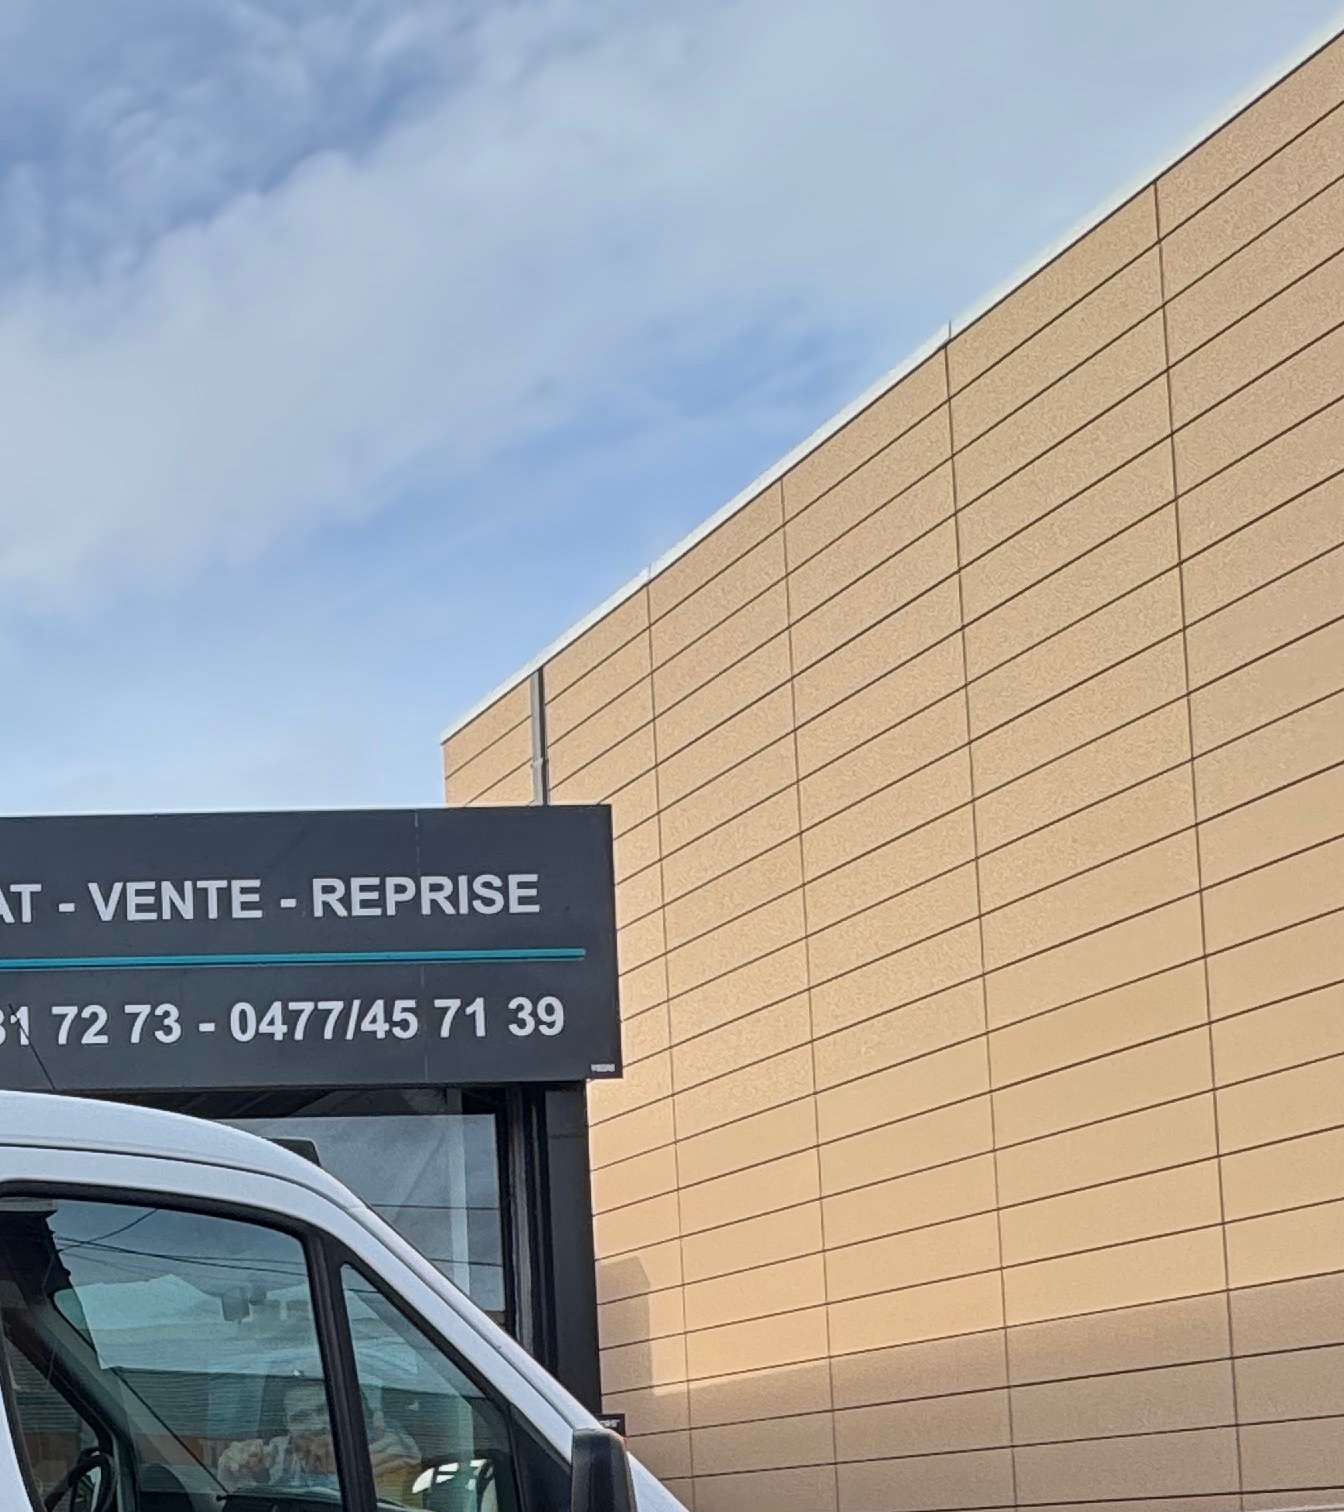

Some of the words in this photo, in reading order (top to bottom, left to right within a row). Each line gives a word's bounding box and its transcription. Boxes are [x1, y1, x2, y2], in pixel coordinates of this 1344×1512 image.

[87, 879, 263, 922] VENTE
[312, 873, 541, 918] REPRISE
[51, 1004, 109, 1045] 72
[124, 1003, 182, 1044] 73
[230, 999, 419, 1042] 0477/45
[433, 998, 486, 1038] 71
[508, 996, 565, 1037] 39
